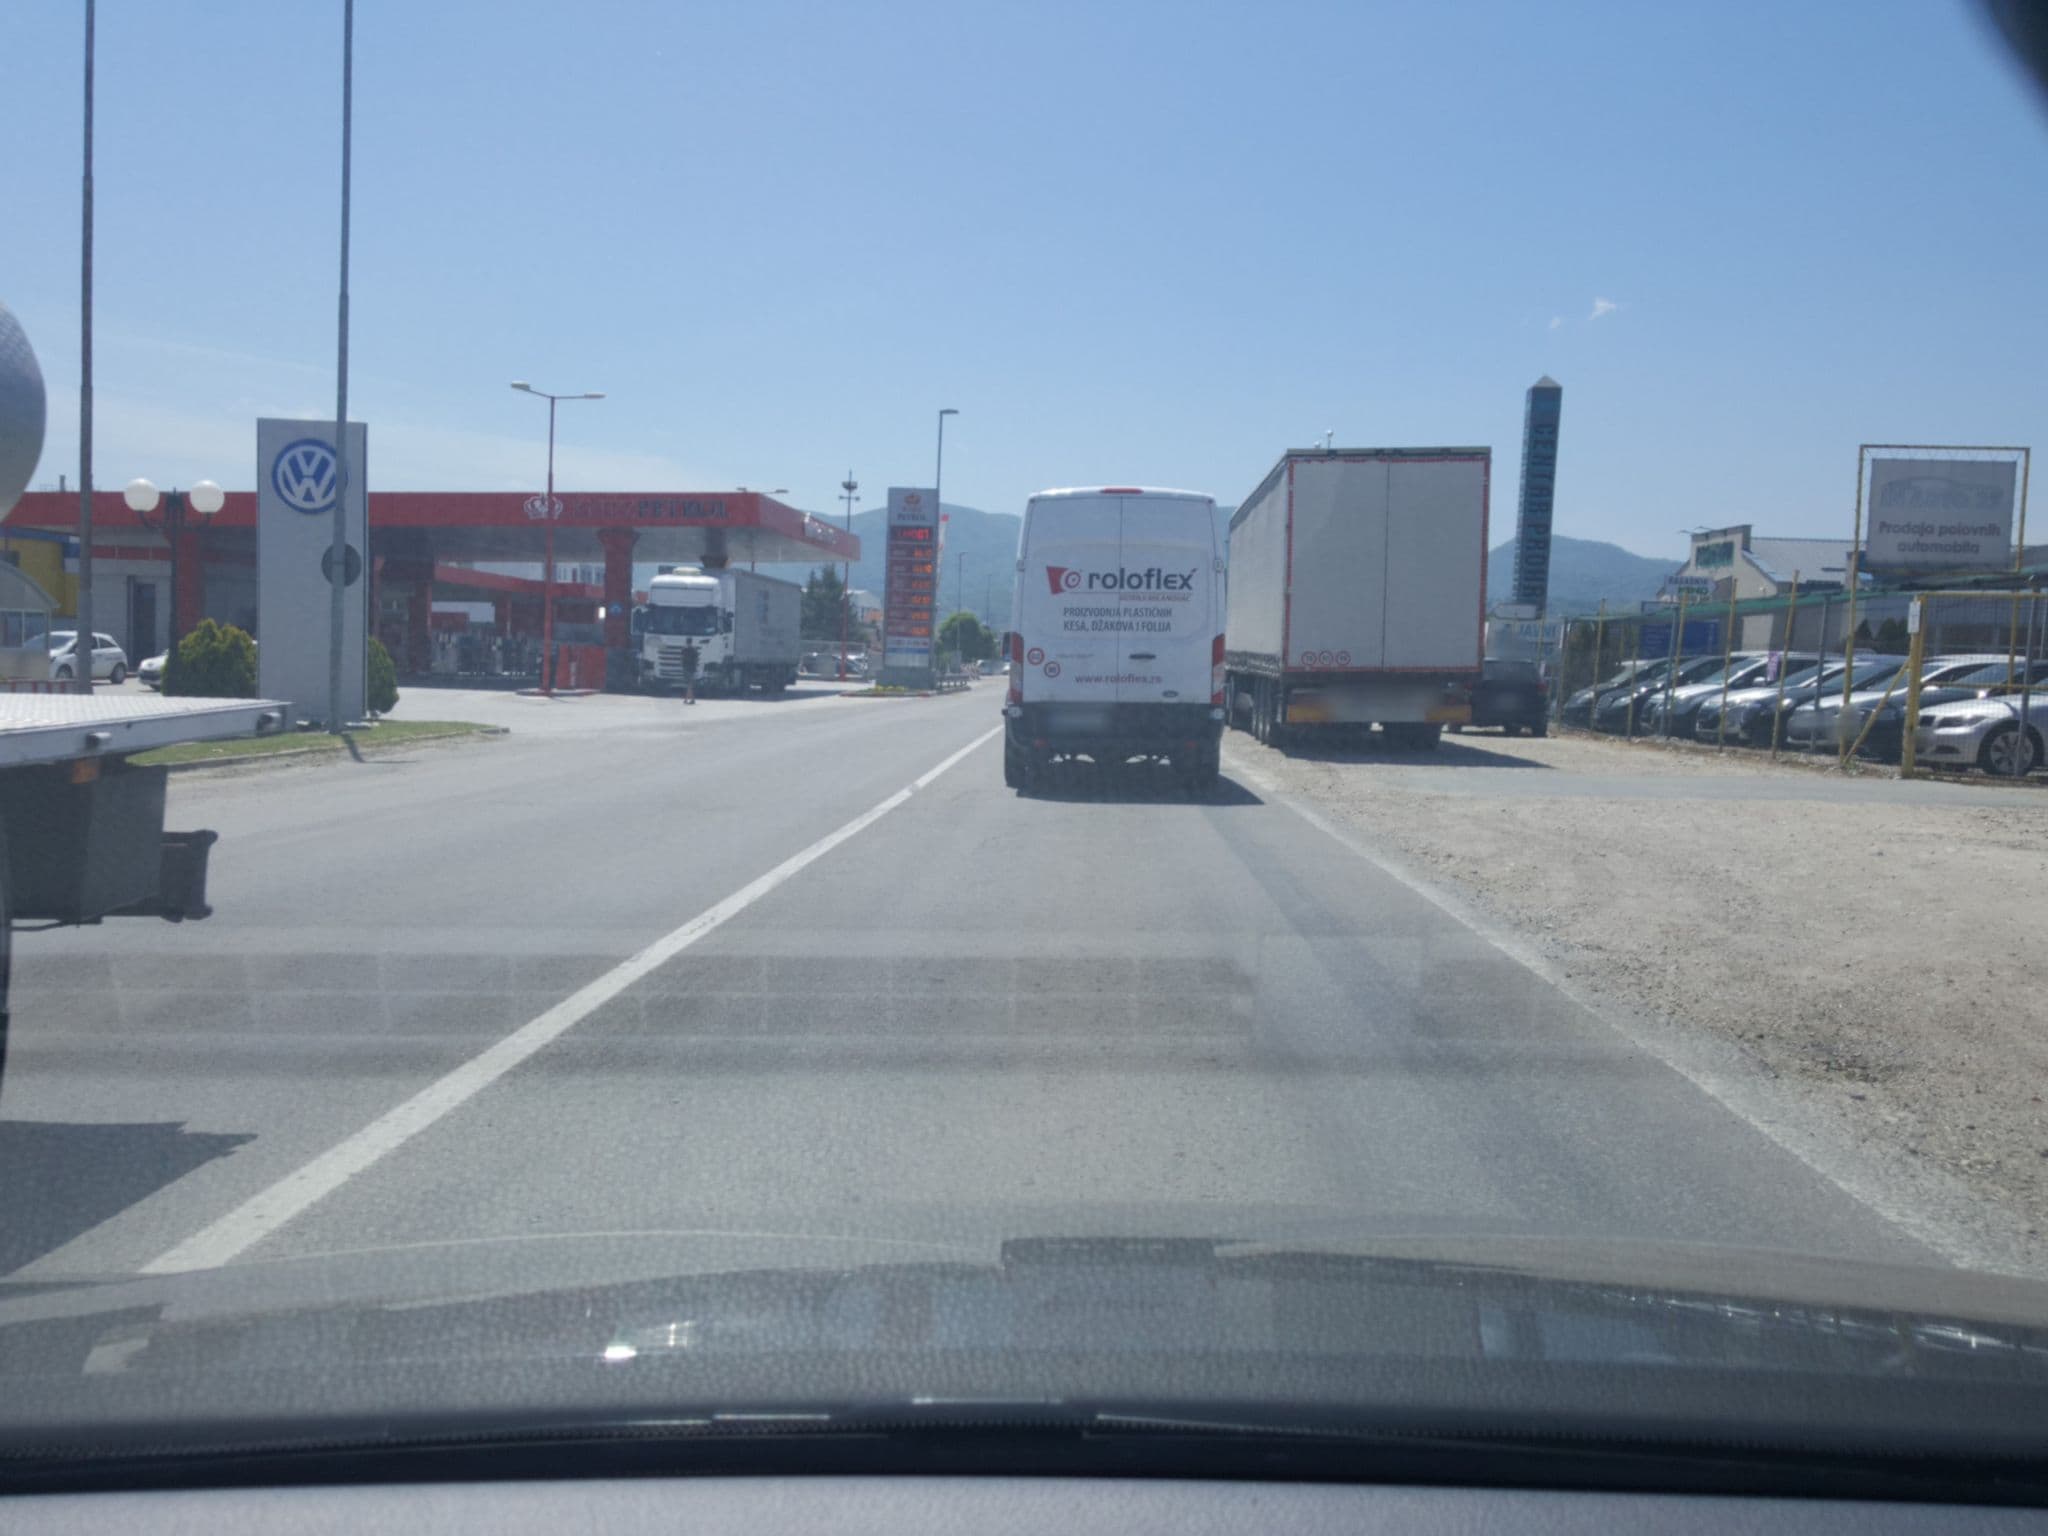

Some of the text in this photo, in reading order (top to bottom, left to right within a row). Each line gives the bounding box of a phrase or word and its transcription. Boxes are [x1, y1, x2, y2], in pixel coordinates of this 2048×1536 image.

[1879, 520, 2001, 537] Prodaja polovnih
[1897, 539, 1980, 554] automobila
[1088, 567, 1196, 590] roloflex
[1063, 606, 1121, 618] PROIZVODNJA
[1075, 673, 1163, 685] www.roloflex.rs
